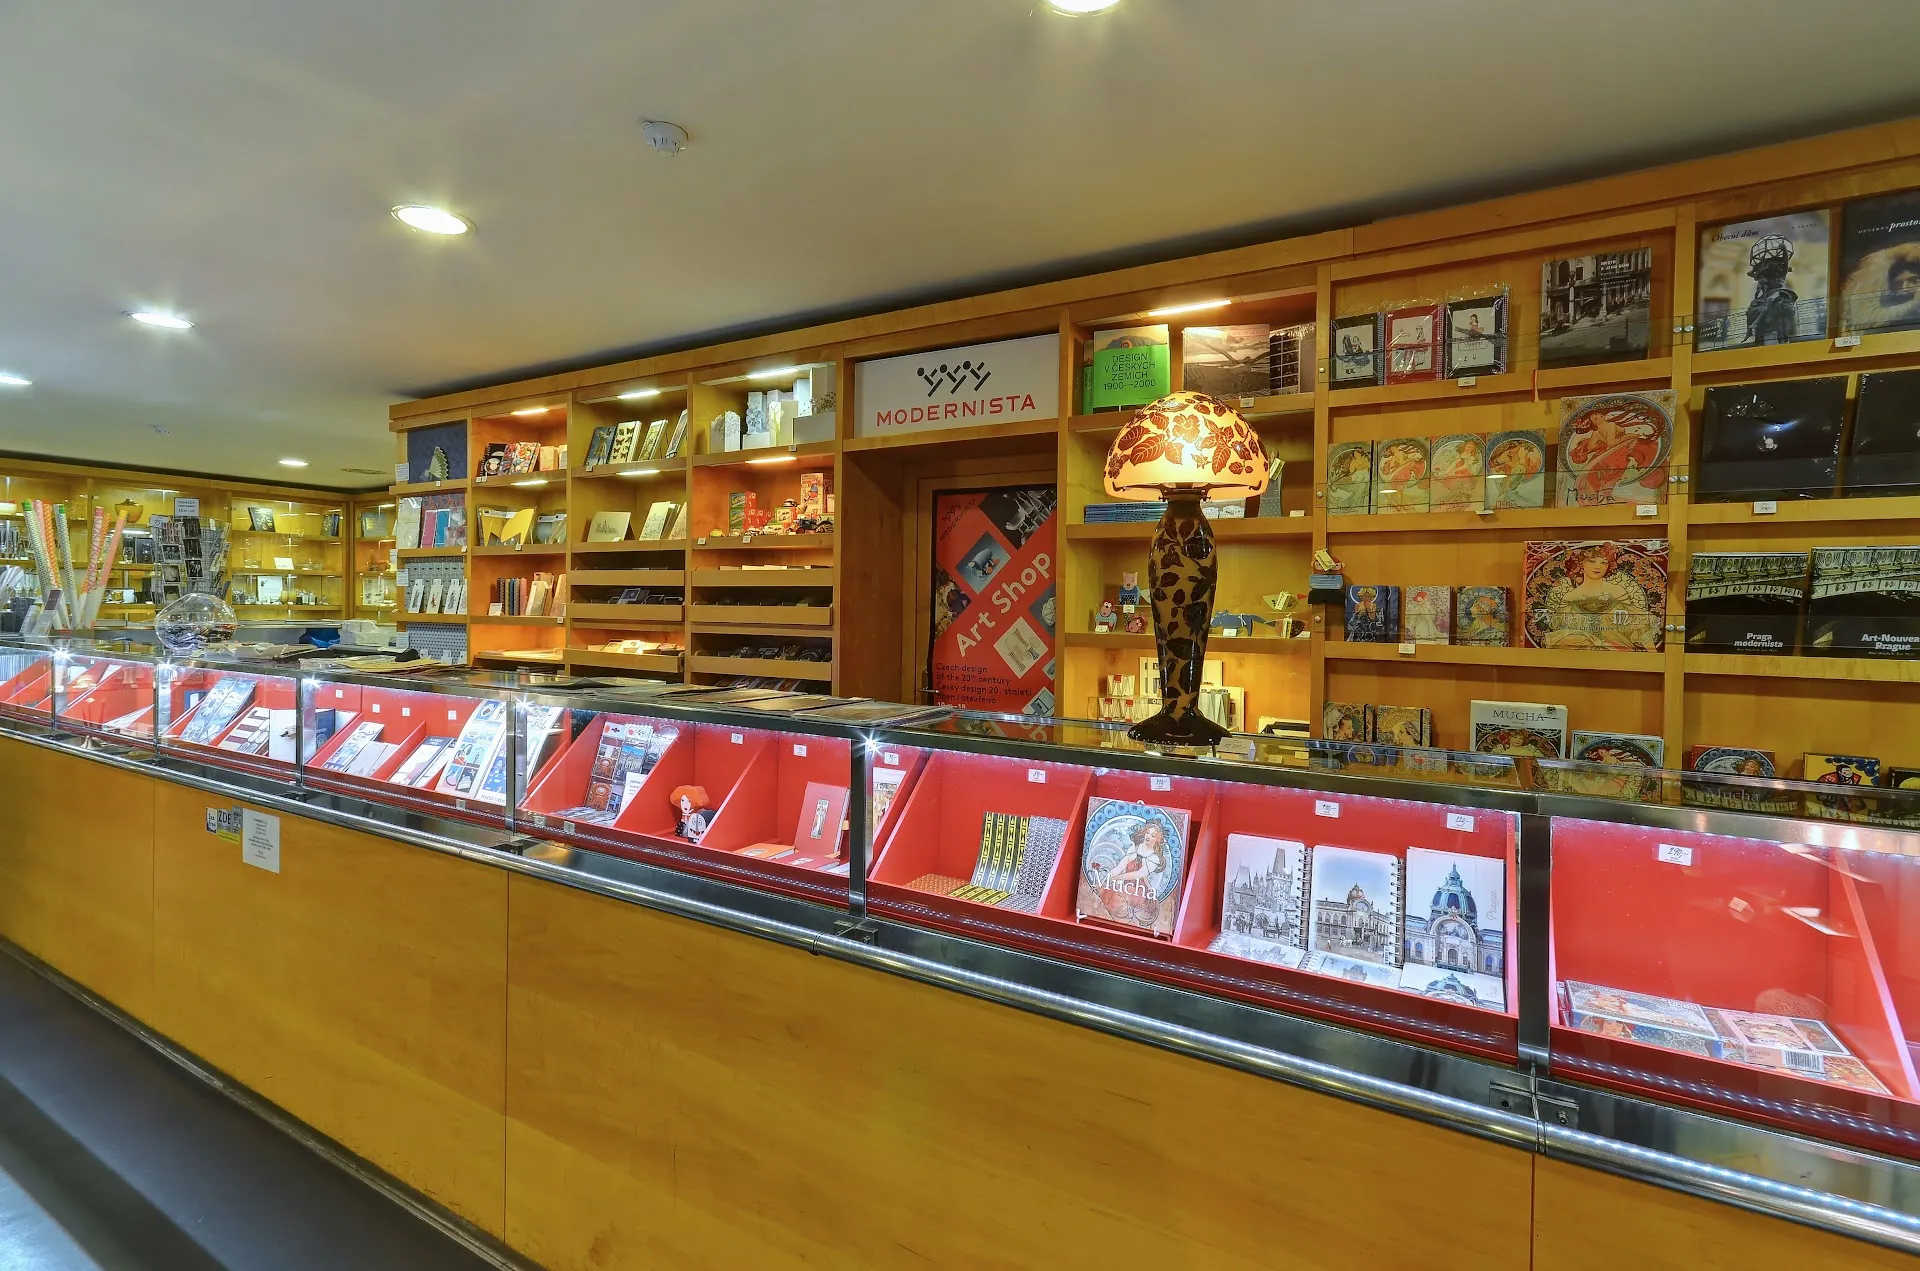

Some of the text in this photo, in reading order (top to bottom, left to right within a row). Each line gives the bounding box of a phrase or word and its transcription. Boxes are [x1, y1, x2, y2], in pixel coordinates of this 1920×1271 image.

[1711, 228, 1760, 243] Obecní dům
[1112, 352, 1148, 363] DESIGN
[1104, 360, 1156, 373] V ČESKÝCH
[1111, 370, 1148, 381] ZEMÍCH
[876, 393, 1036, 427] MODERNISTA
[1566, 487, 1616, 506] Mucha
[956, 552, 1051, 658] Art Shop
[1733, 639, 1784, 648] modernista
[1746, 632, 1773, 642] Praga
[1861, 633, 1920, 643] Art-Nouvea
[1875, 641, 1911, 652] Prague
[936, 663, 988, 674] Czech design
[978, 677, 1011, 686] century
[961, 683, 987, 694] design
[1492, 709, 1545, 722] MUCHA
[1705, 787, 1760, 802] Mucha
[218, 810, 231, 825] ZDE
[1091, 869, 1158, 901] Mucha
[1486, 890, 1499, 921] Prague
